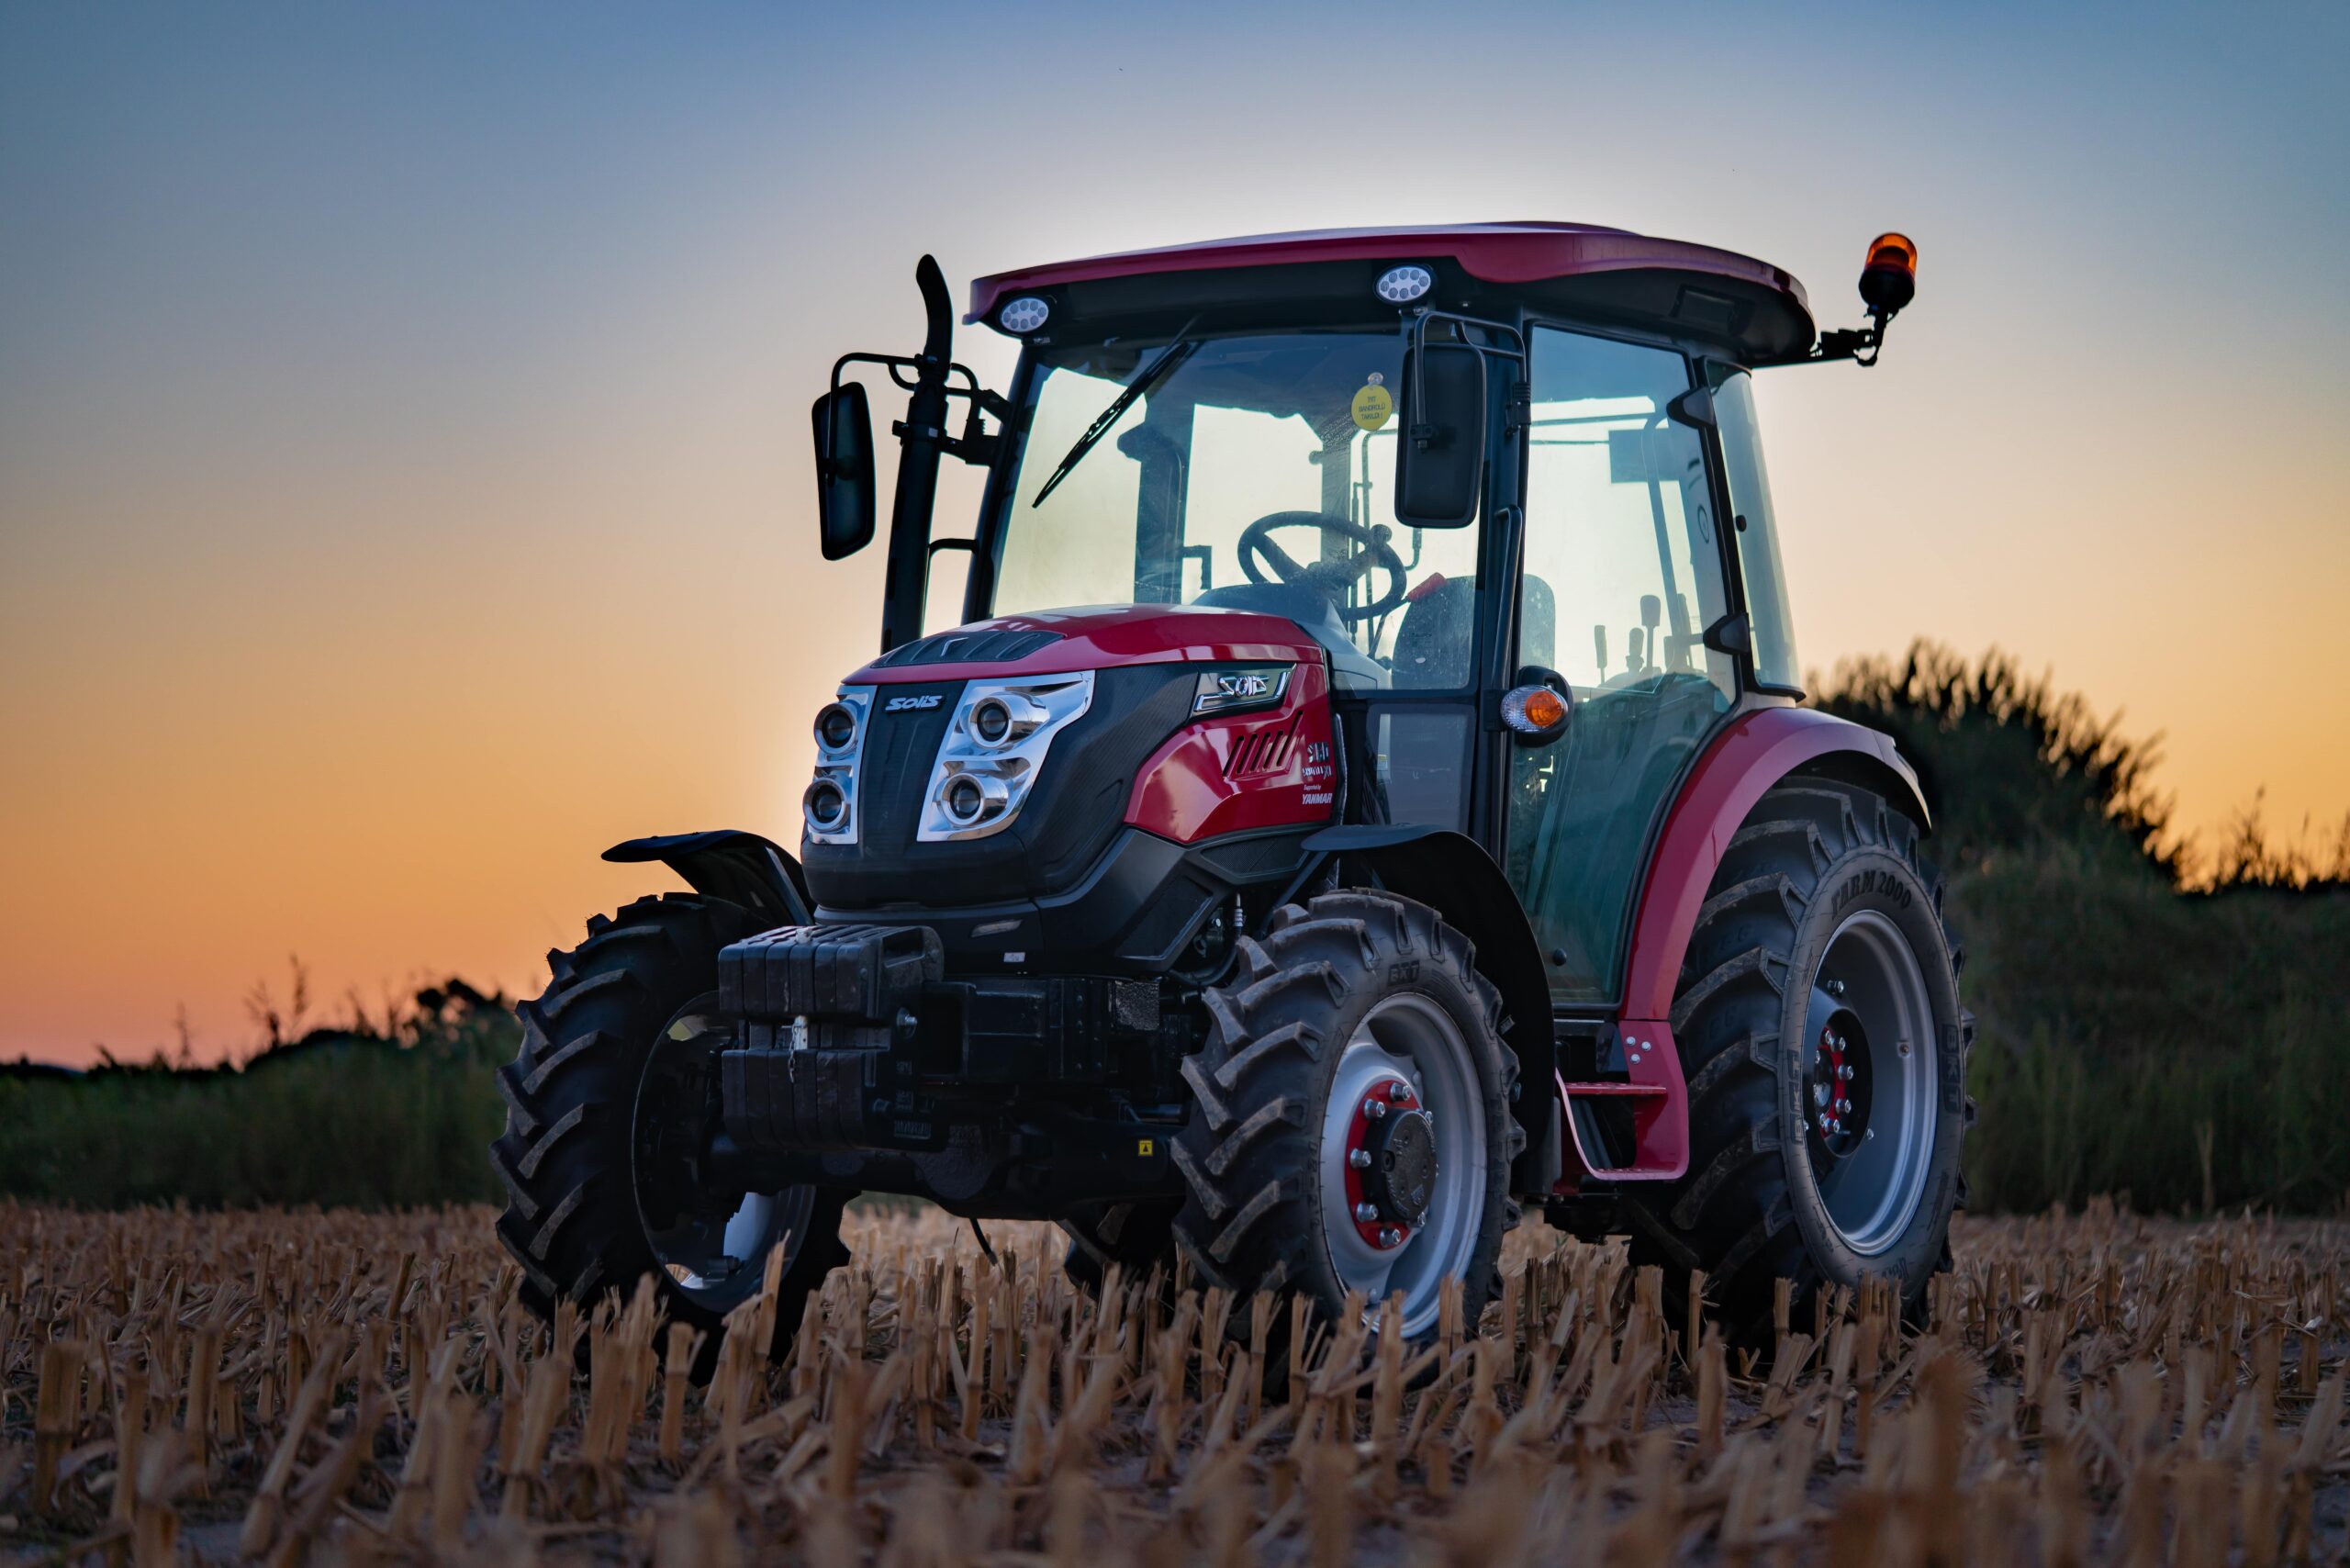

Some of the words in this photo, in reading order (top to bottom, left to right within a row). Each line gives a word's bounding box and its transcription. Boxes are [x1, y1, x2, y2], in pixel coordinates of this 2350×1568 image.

[1302, 792, 1333, 805] YANMAR
[1831, 869, 1876, 919] FARM
[1878, 875, 1912, 910] 2000
[1388, 960, 1420, 987] BKT
[1942, 1024, 1962, 1114] BKT
